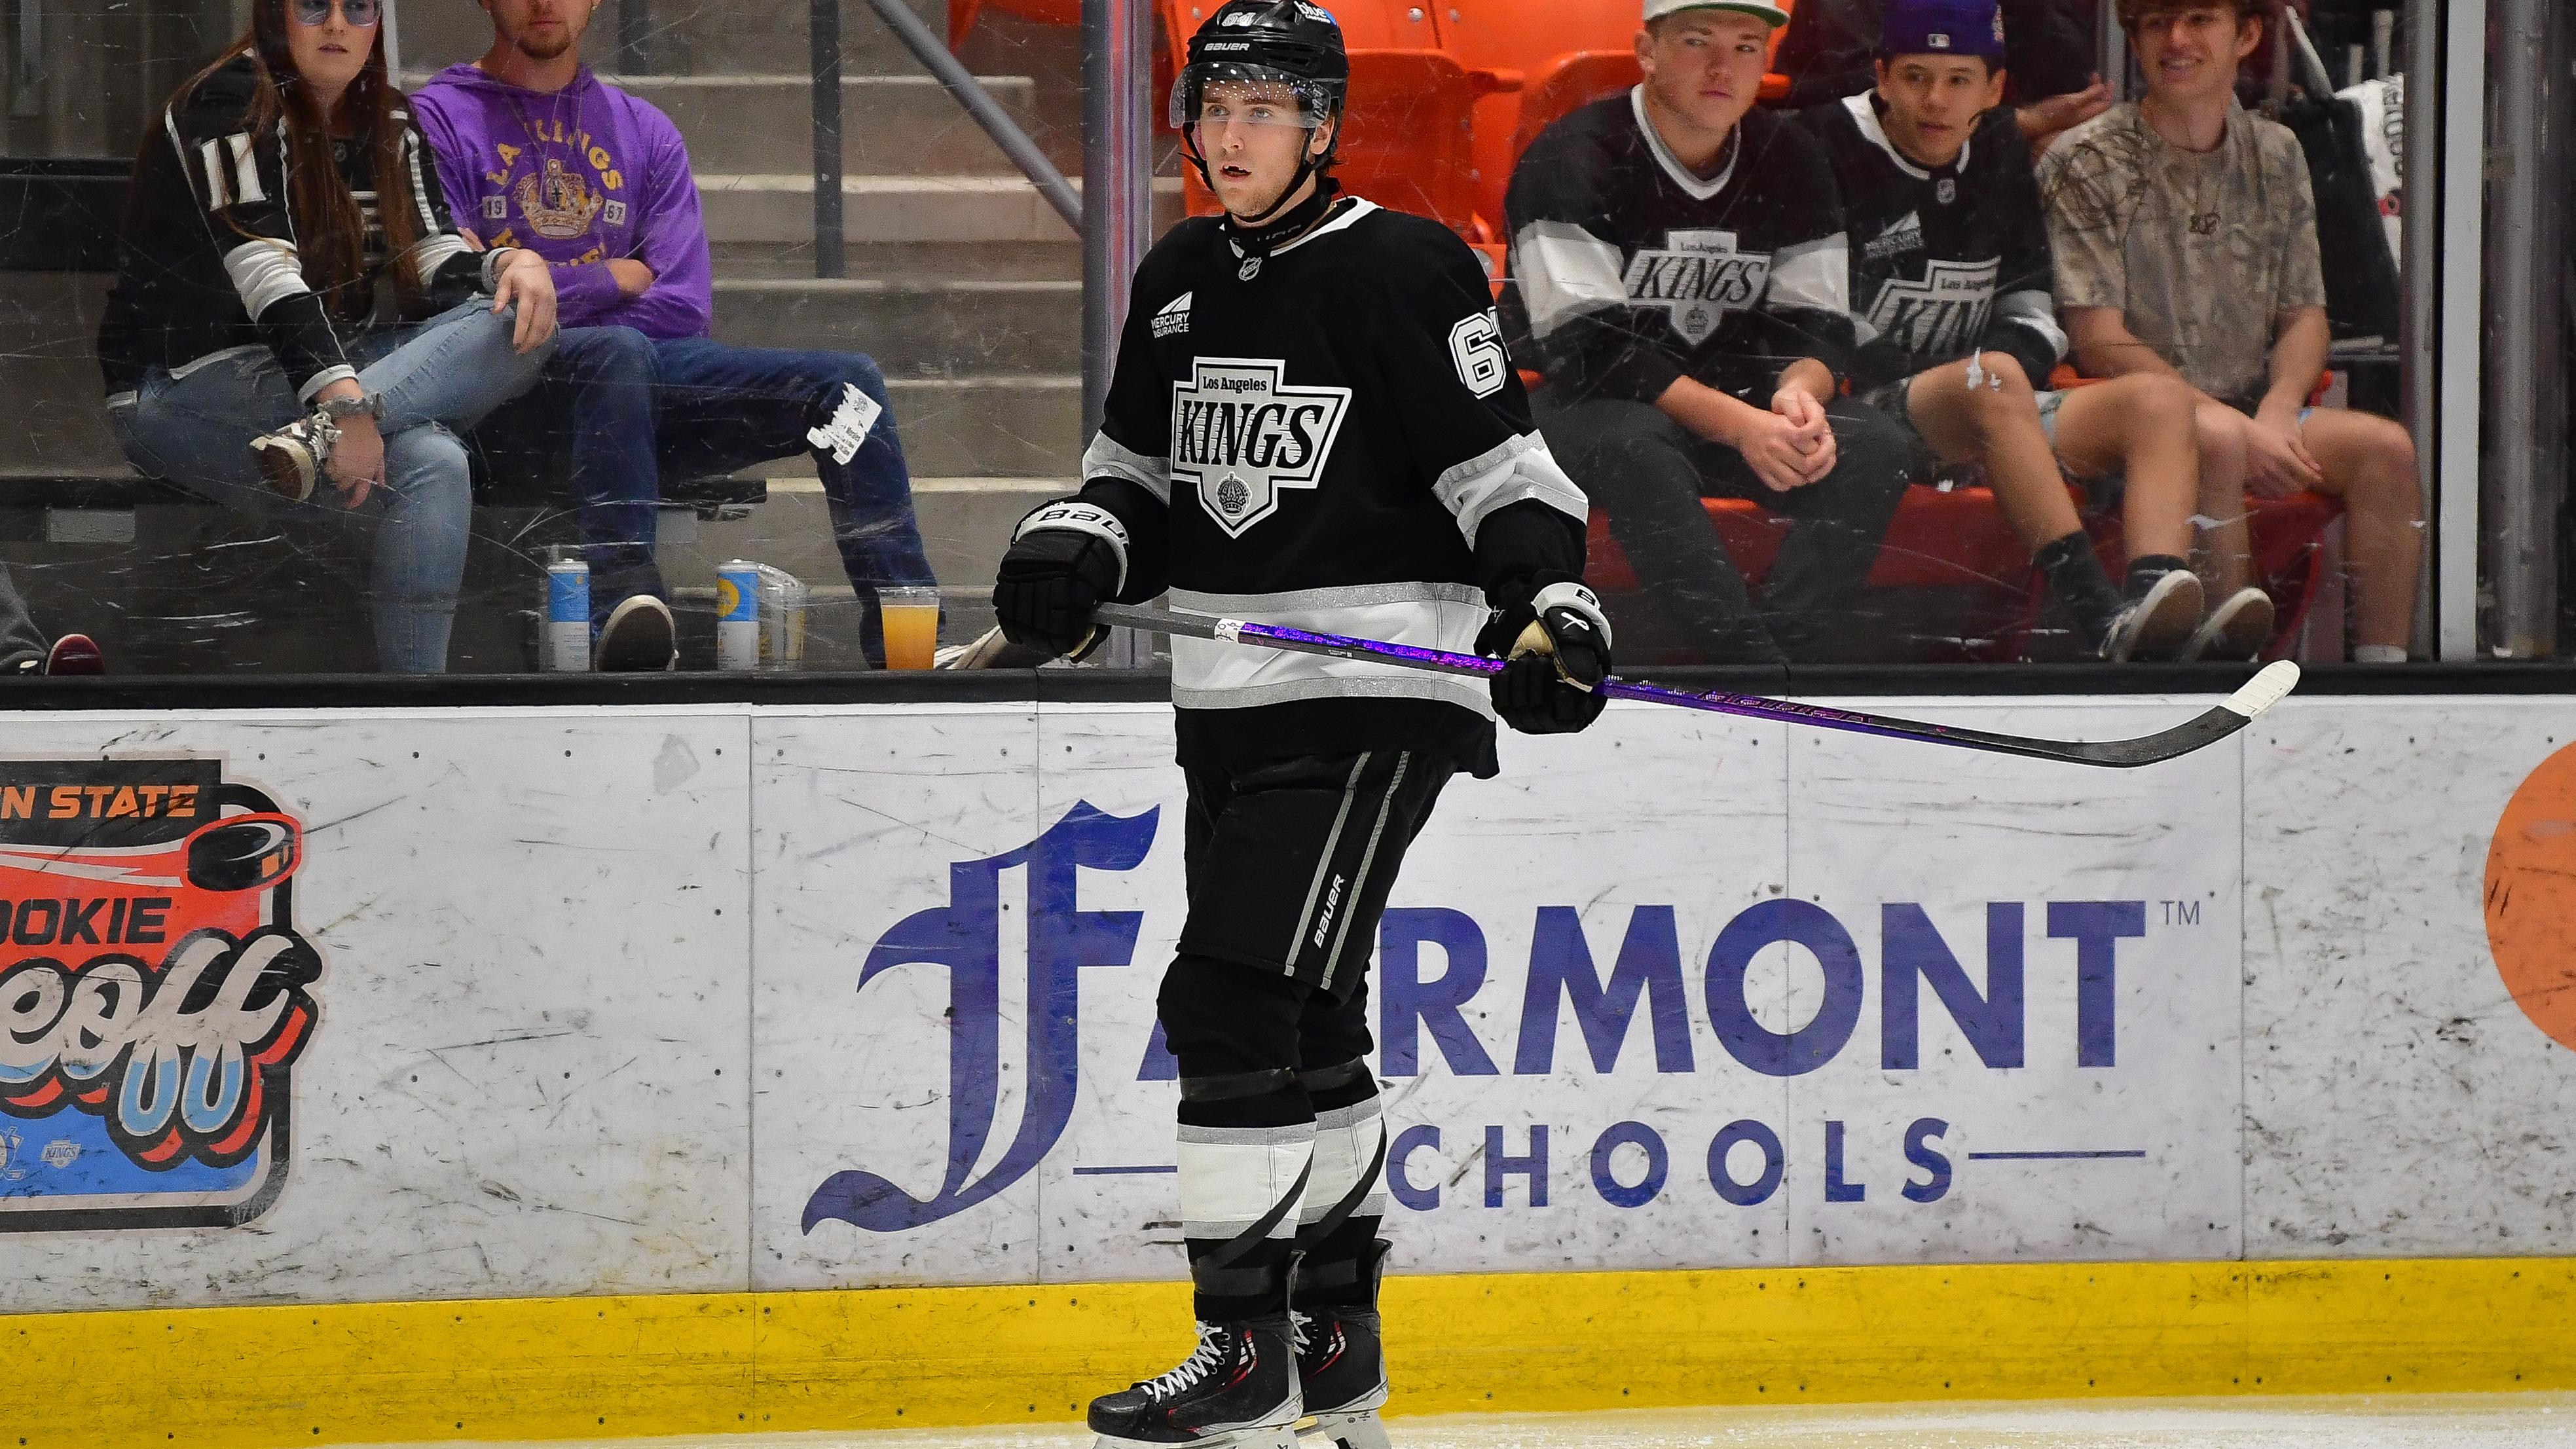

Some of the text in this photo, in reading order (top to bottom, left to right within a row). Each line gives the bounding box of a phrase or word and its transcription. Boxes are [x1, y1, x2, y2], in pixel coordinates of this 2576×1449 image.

[1204, 43, 1250, 51] BAUER
[201, 131, 267, 211] 11
[1628, 256, 1765, 304] KINGS
[1150, 312, 1190, 329] MERCURY
[1448, 305, 1511, 400] 6
[1202, 375, 1268, 394] Los Angeles
[1179, 399, 1325, 469] KINGS
[1037, 509, 1130, 551] BAU
[0, 785, 199, 818] N STATE
[0, 897, 172, 945] OKIE
[1314, 873, 1346, 949] BAUER
[801, 798, 2201, 1237] FRMONT TM
[1386, 1116, 1953, 1211] CHOOLS
